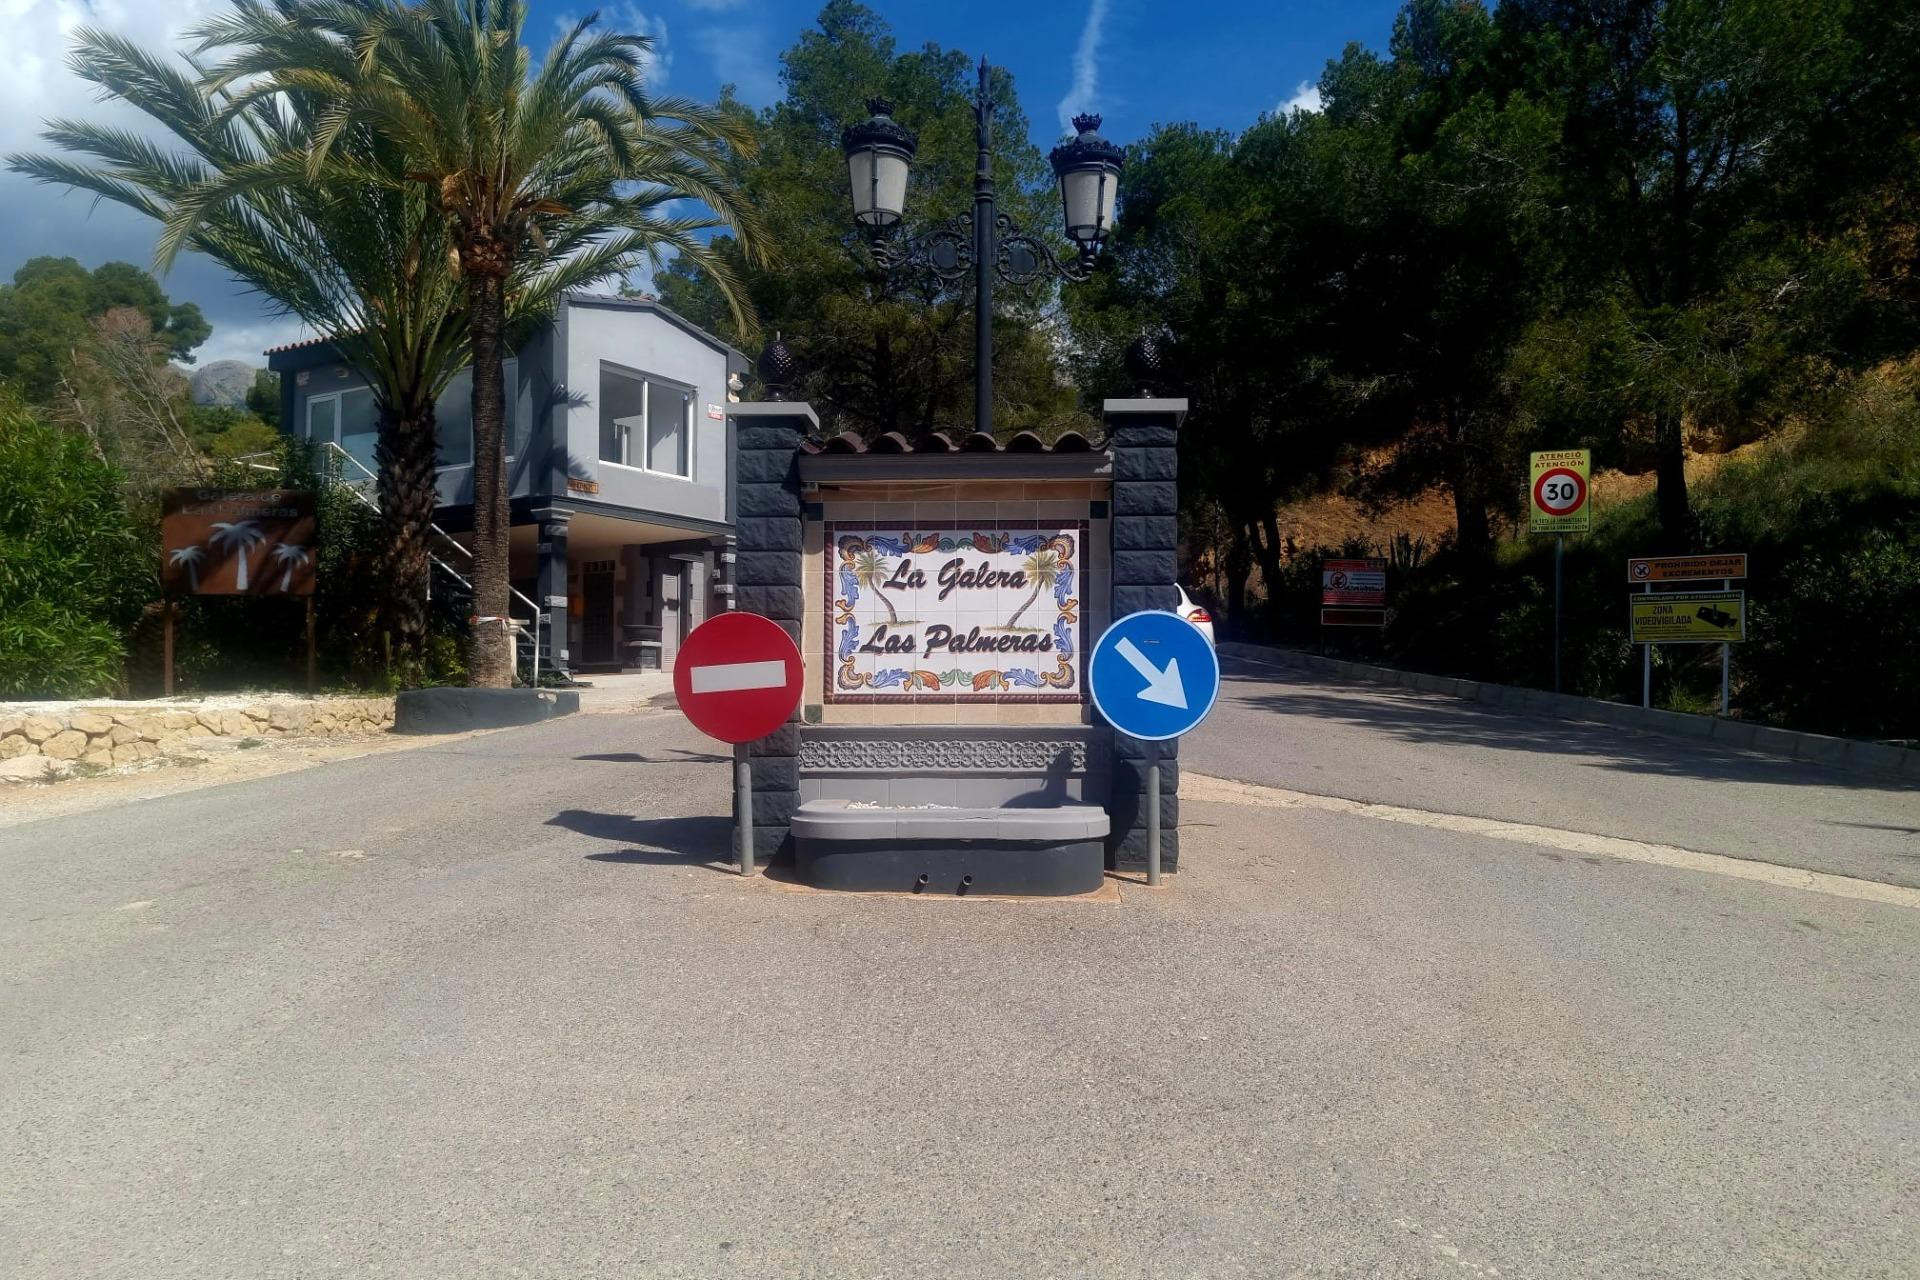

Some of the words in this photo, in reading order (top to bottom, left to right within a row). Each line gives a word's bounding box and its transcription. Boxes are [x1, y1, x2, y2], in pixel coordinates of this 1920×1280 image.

[1535, 460, 1584, 468] ATENCIÓN
[1547, 483, 1574, 500] 30
[1655, 560, 1706, 569] PROHIBIDO
[1710, 558, 1742, 567] DEJAR
[1663, 568, 1734, 577] EXCREMENTOS
[883, 558, 926, 590] La
[937, 557, 1028, 601] Galera
[1653, 605, 1673, 614] ZONA
[1635, 615, 1692, 625] VIDEOVIGILADA
[859, 624, 916, 654] Las
[923, 624, 1054, 659] Palmeras
